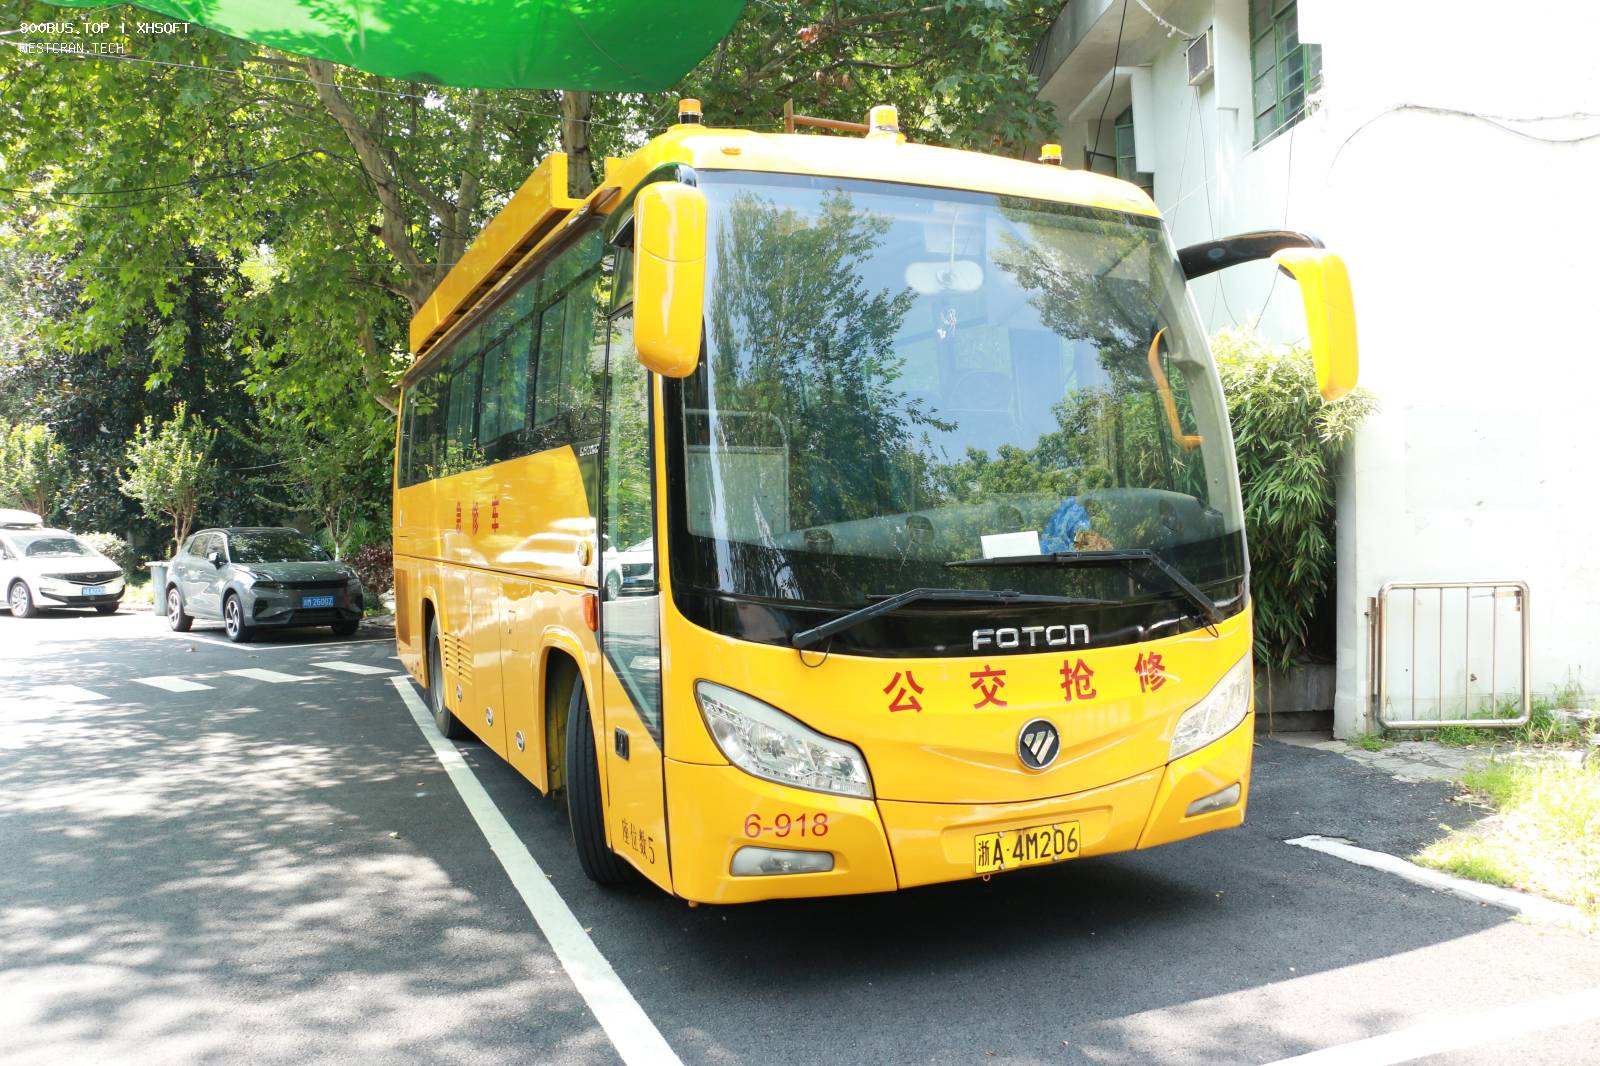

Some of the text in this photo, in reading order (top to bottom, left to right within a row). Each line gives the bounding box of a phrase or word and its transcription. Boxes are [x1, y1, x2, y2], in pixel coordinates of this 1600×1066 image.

[972, 624, 1090, 651] FOTON
[883, 651, 1168, 713] 公交抢修
[744, 813, 829, 838] 6-918
